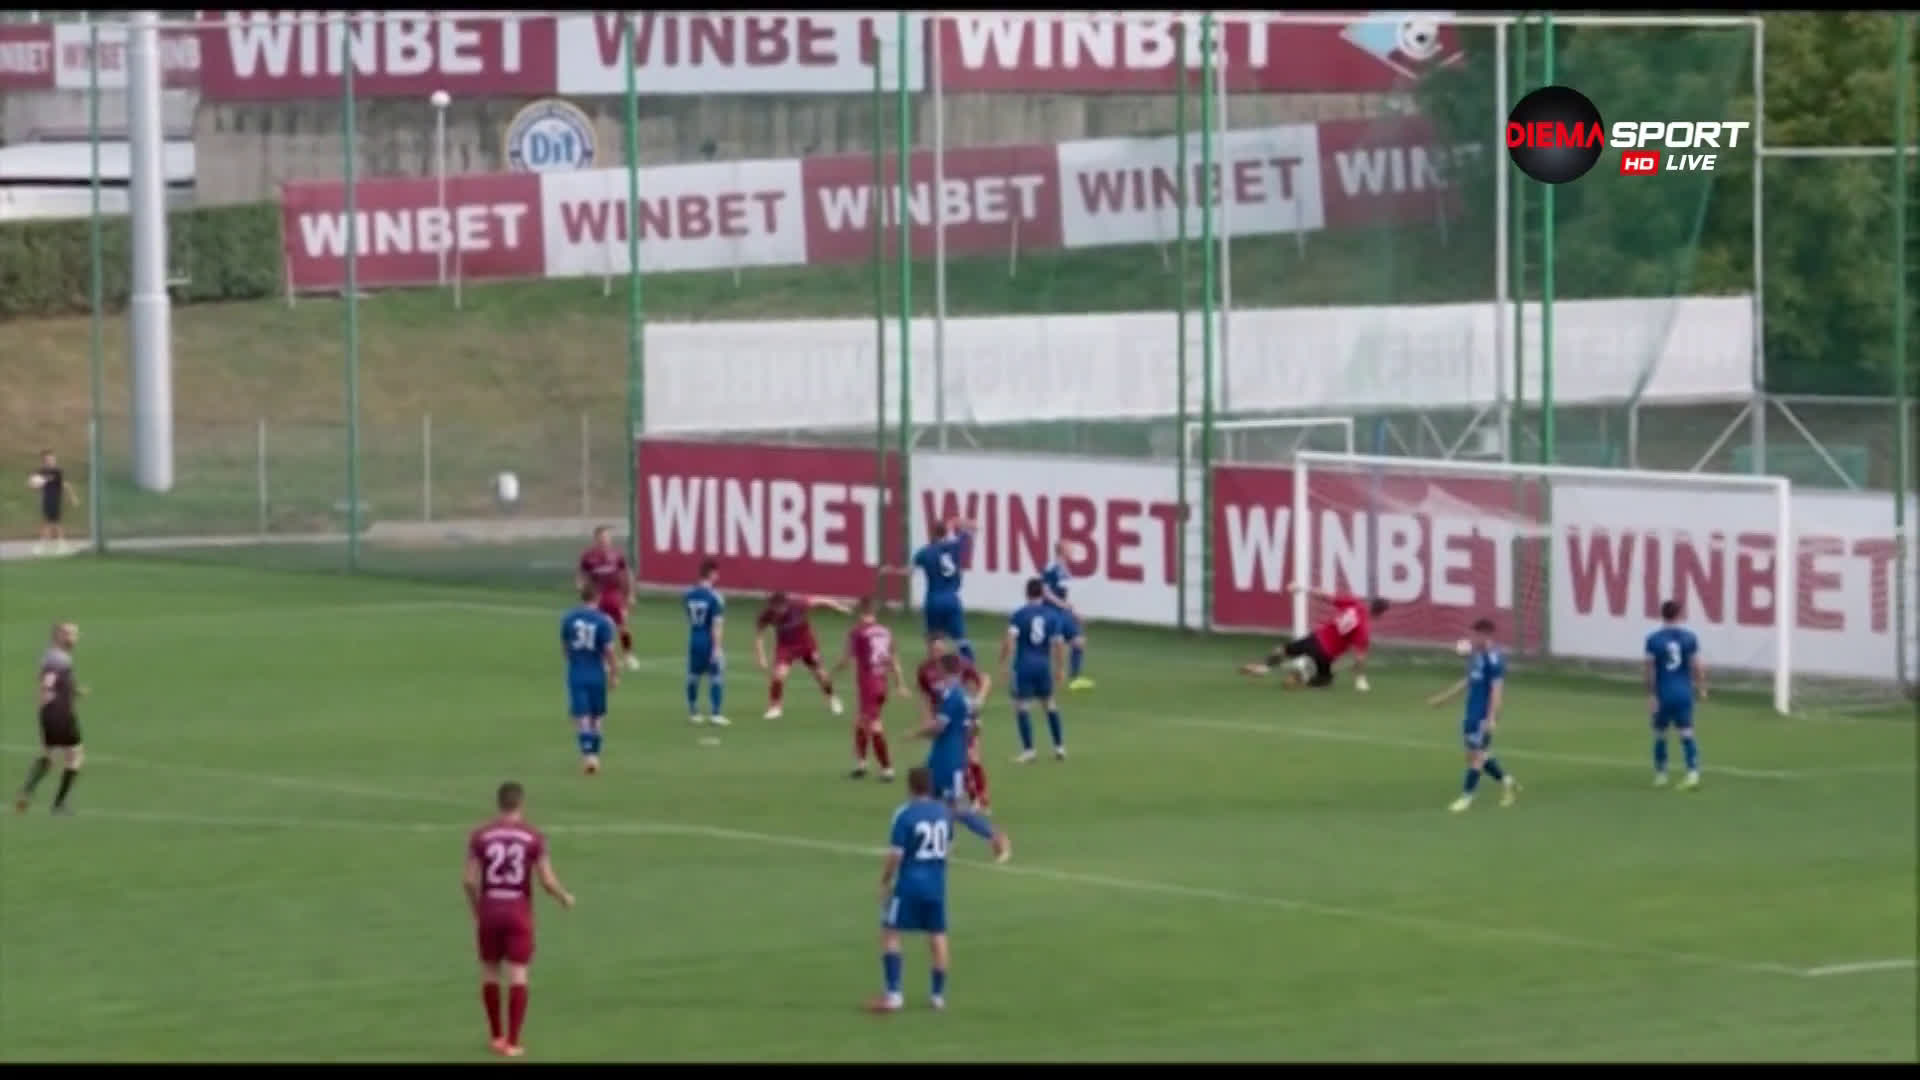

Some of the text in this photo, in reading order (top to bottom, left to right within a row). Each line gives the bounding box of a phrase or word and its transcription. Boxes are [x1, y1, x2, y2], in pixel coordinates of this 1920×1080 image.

[225, 11, 530, 77] WINBET
[818, 174, 1045, 232] WINBET
[1077, 157, 1304, 213] WINBET
[299, 203, 528, 258] WINBET
[560, 190, 786, 244] WINBET
[649, 474, 891, 566] WINBET
[921, 489, 1191, 585] WINBET
[1224, 504, 1520, 609] WNBET
[1566, 523, 1898, 634] WINBET
[573, 619, 598, 650] 31
[1030, 615, 1045, 644] 8
[1664, 641, 1682, 670] 3
[485, 841, 525, 884] 23
[915, 820, 948, 860] 20
